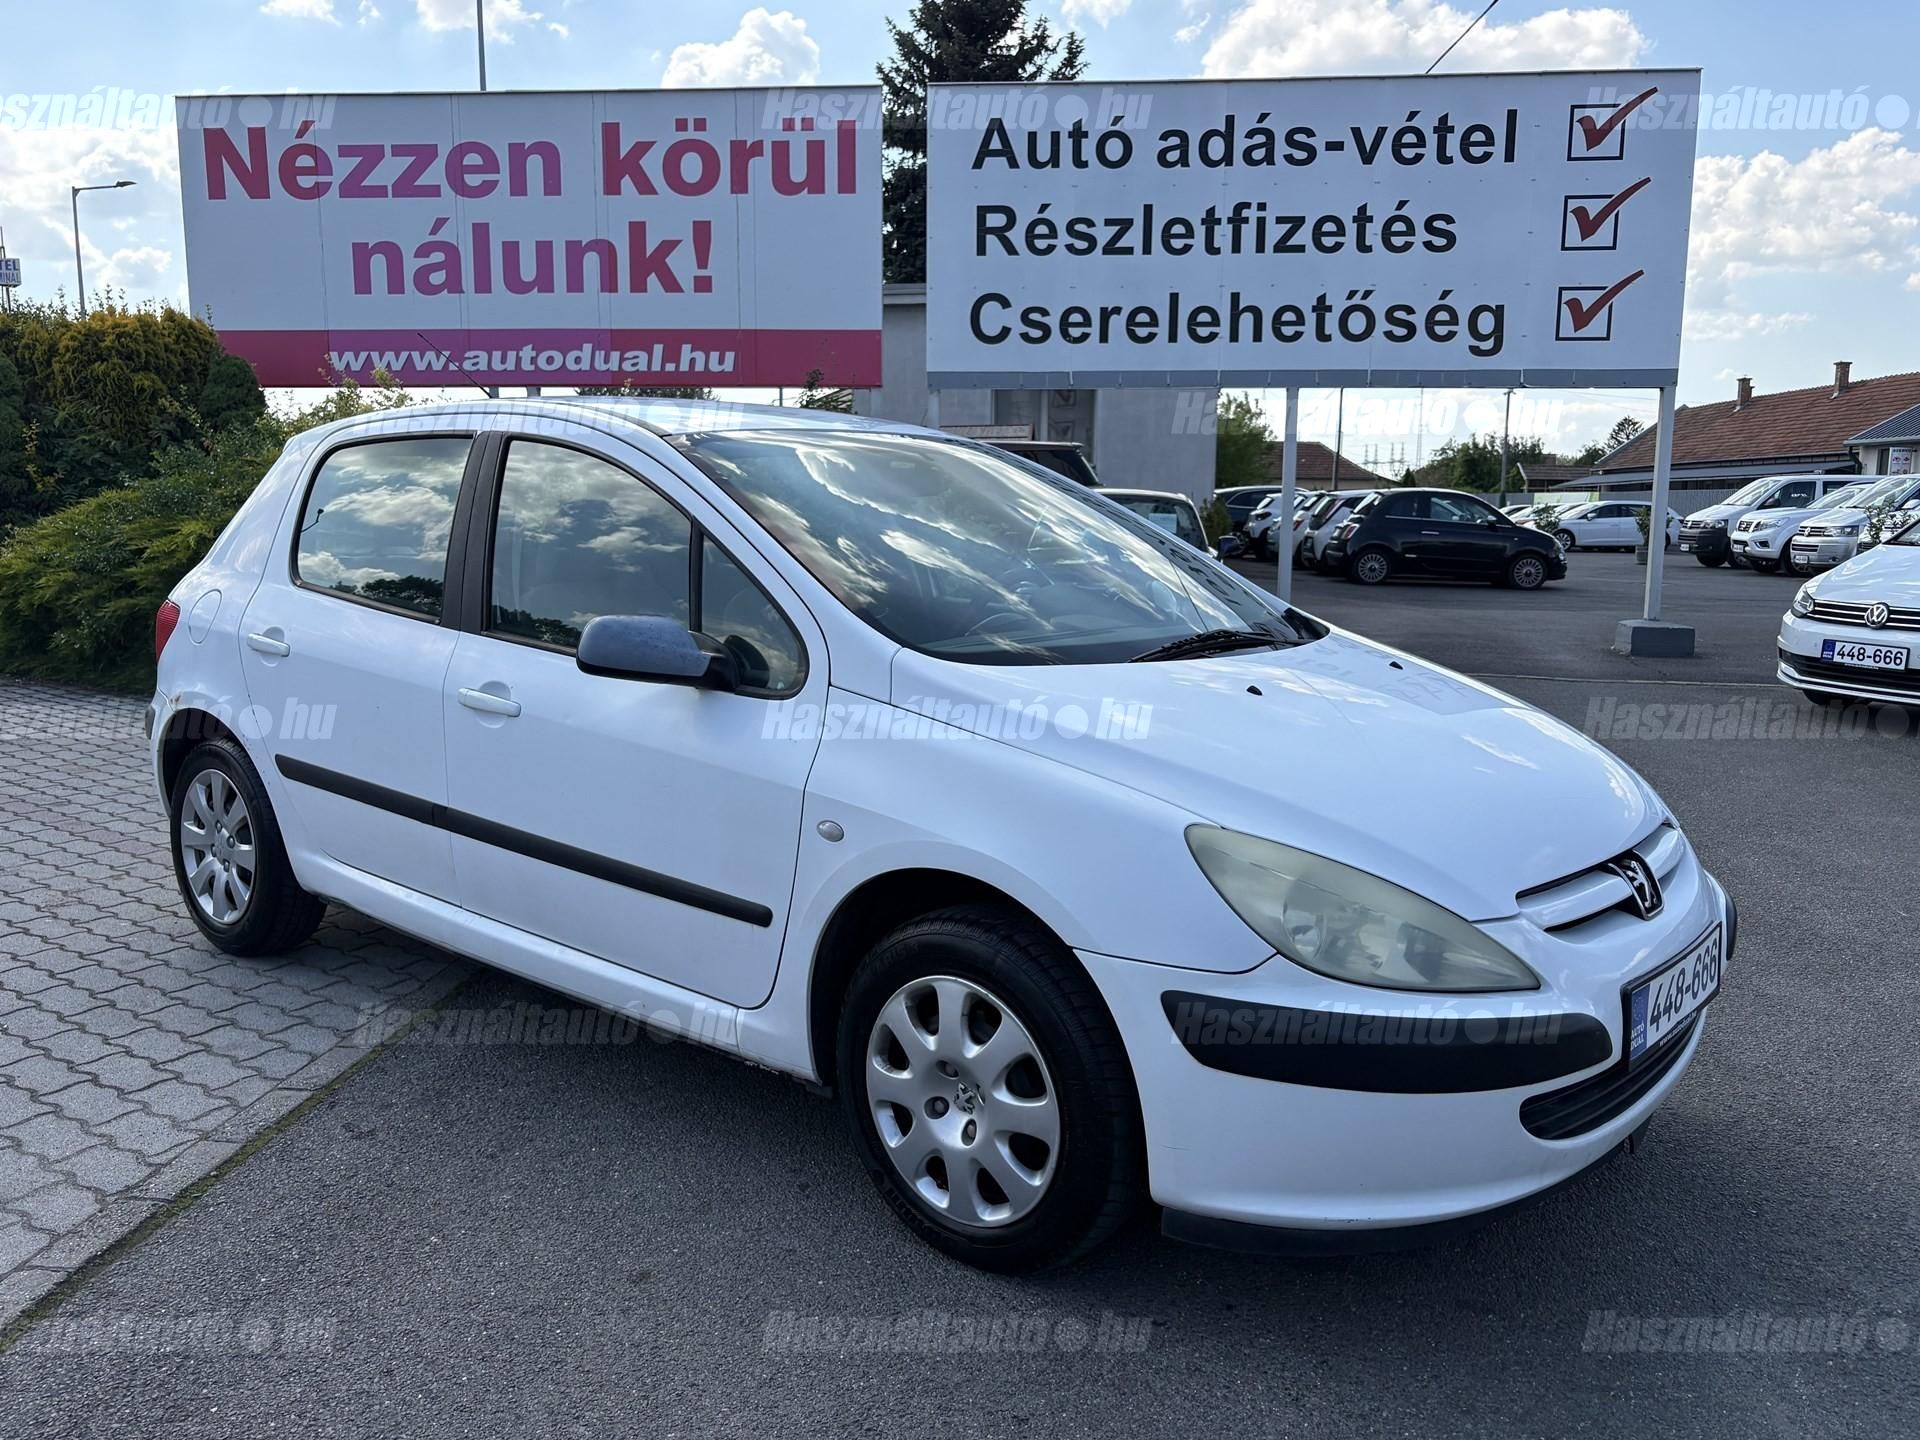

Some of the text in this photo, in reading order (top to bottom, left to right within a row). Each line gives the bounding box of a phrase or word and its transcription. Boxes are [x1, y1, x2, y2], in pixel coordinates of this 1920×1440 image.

[203, 117, 857, 200] Nézzen körül
[971, 108, 1518, 171] Autó adás-vétel
[351, 217, 713, 295] nálunk!
[975, 199, 1457, 257] Részletfizetés
[970, 289, 1505, 358] Cserelehetőség
[329, 342, 736, 373] www.autodual.hu
[1836, 644, 1904, 667] 448-666
[1649, 938, 1717, 1033] 448-666
